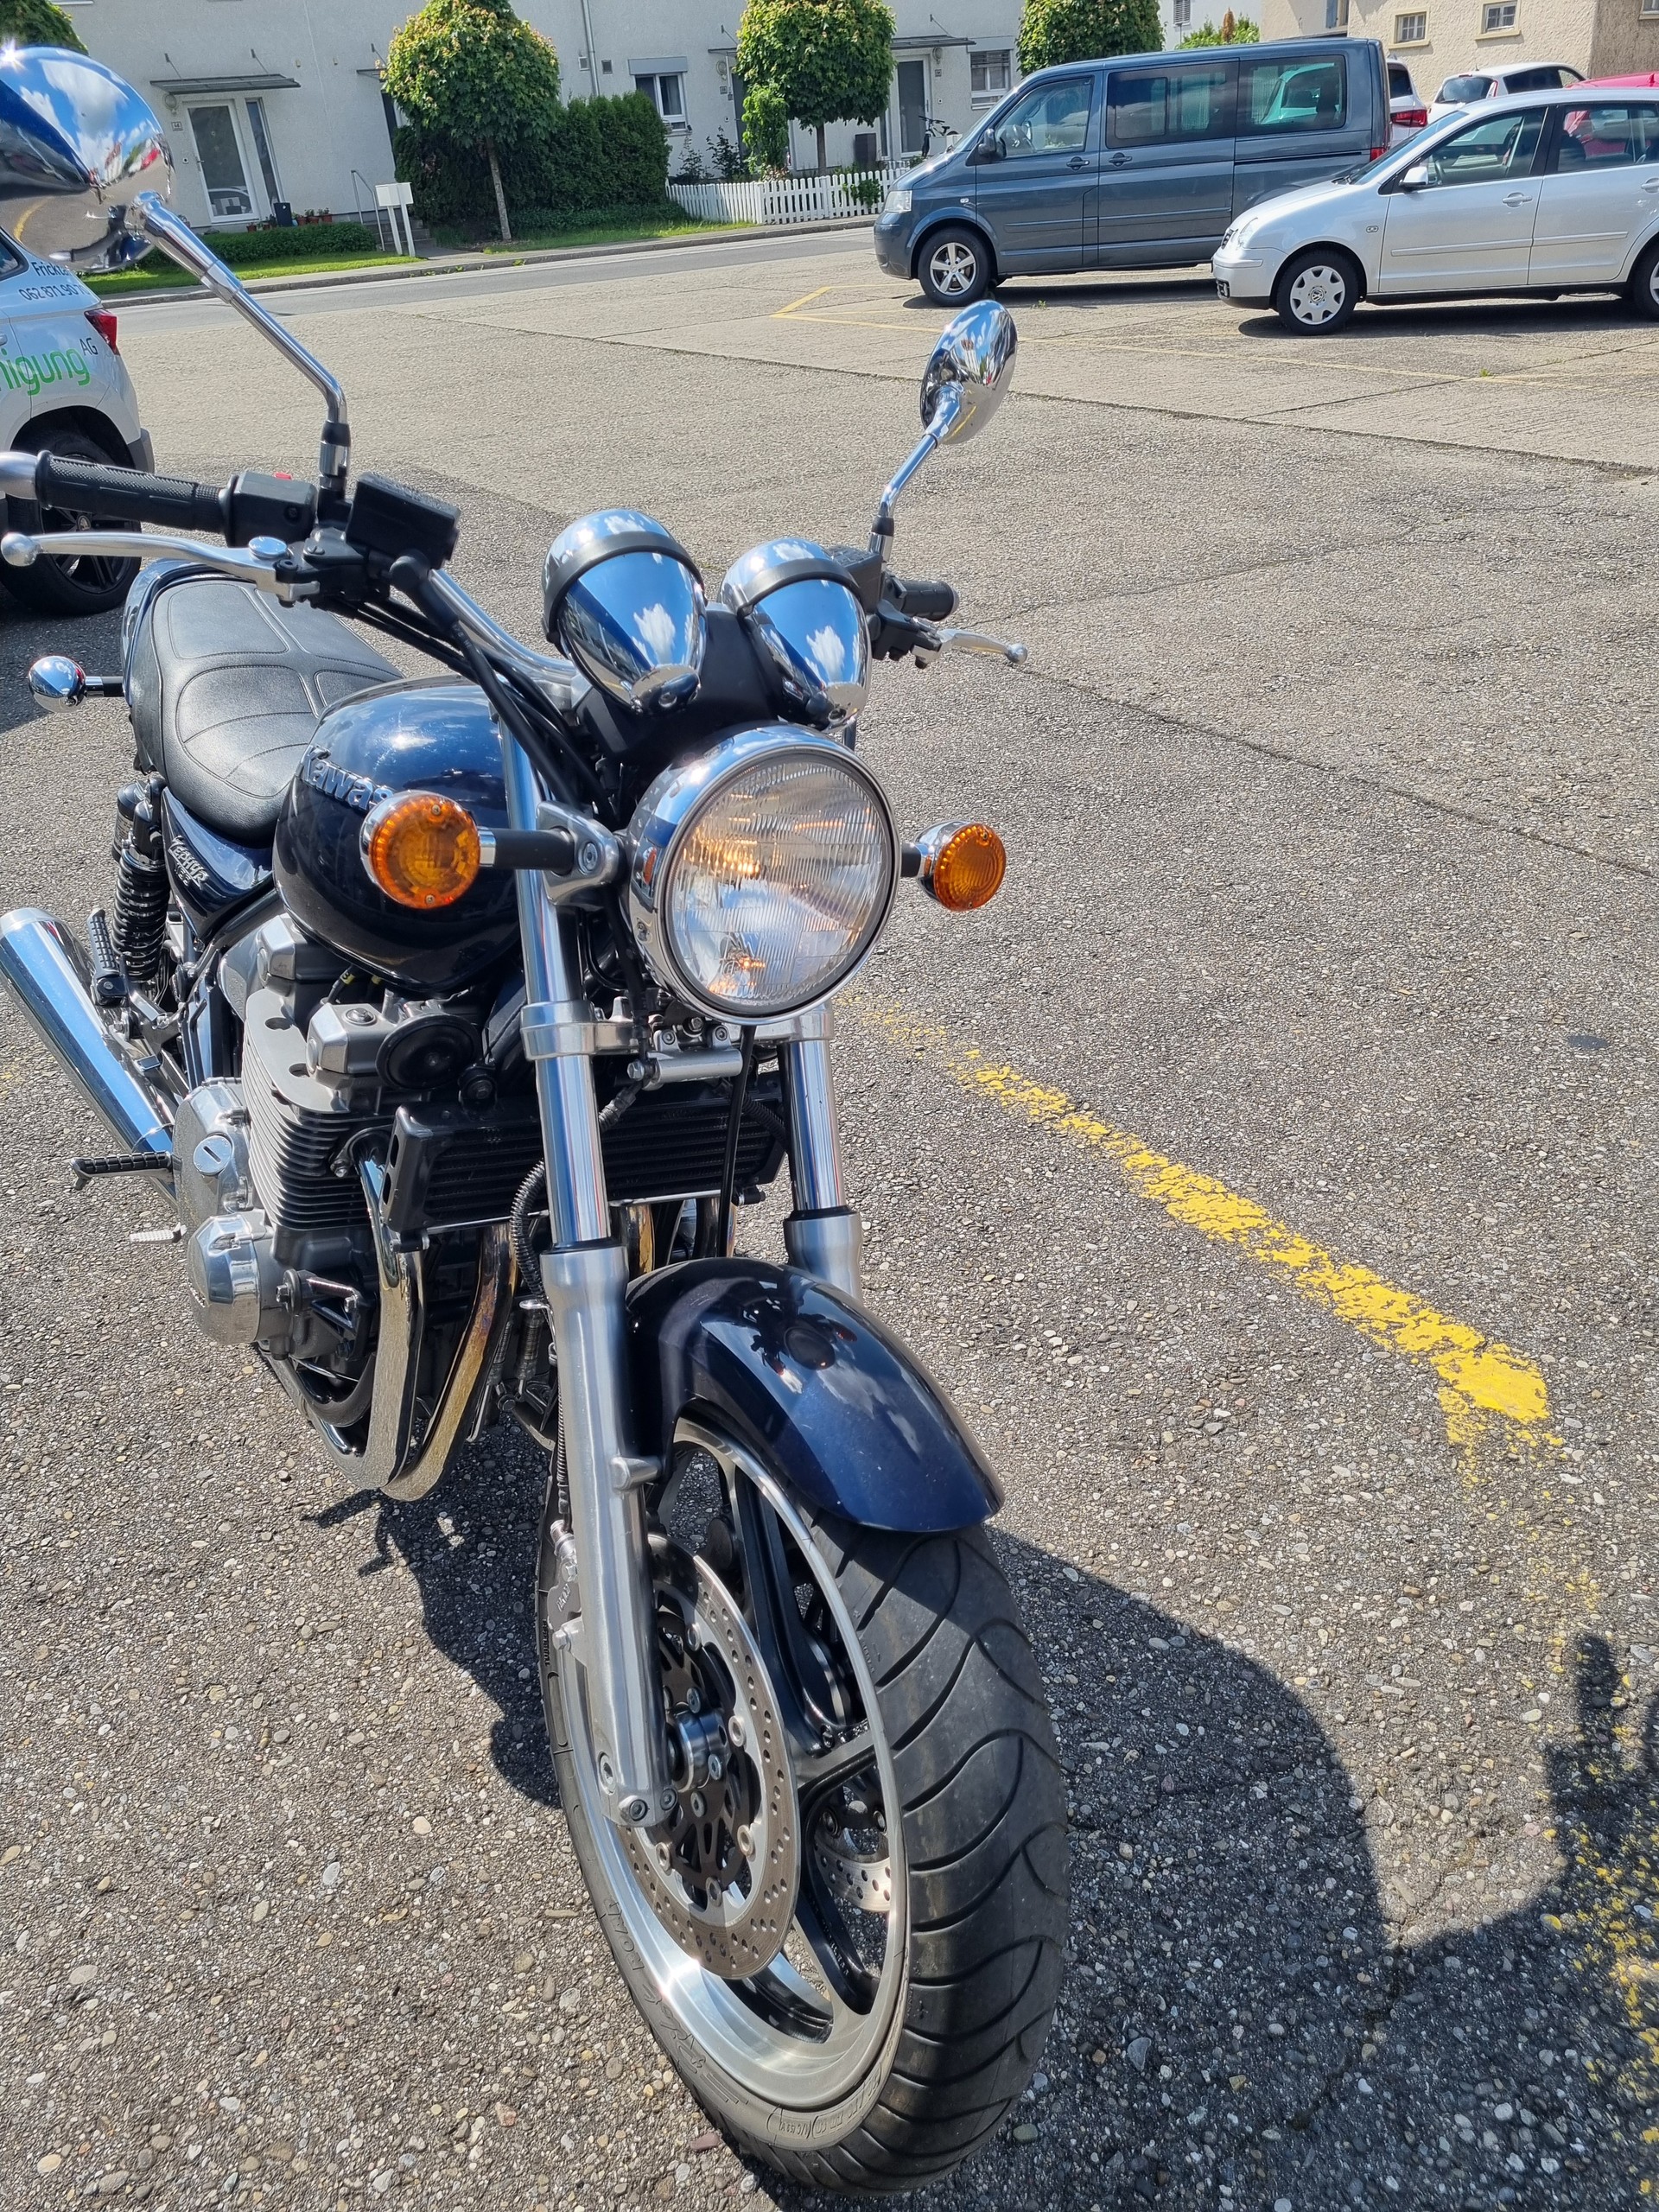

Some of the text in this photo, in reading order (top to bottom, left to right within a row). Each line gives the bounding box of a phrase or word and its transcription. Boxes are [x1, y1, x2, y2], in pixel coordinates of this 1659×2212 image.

[19, 287, 46, 301] 062
[41, 285, 66, 298] 871
[60, 283, 79, 296] 90
[79, 338, 99, 355] AG
